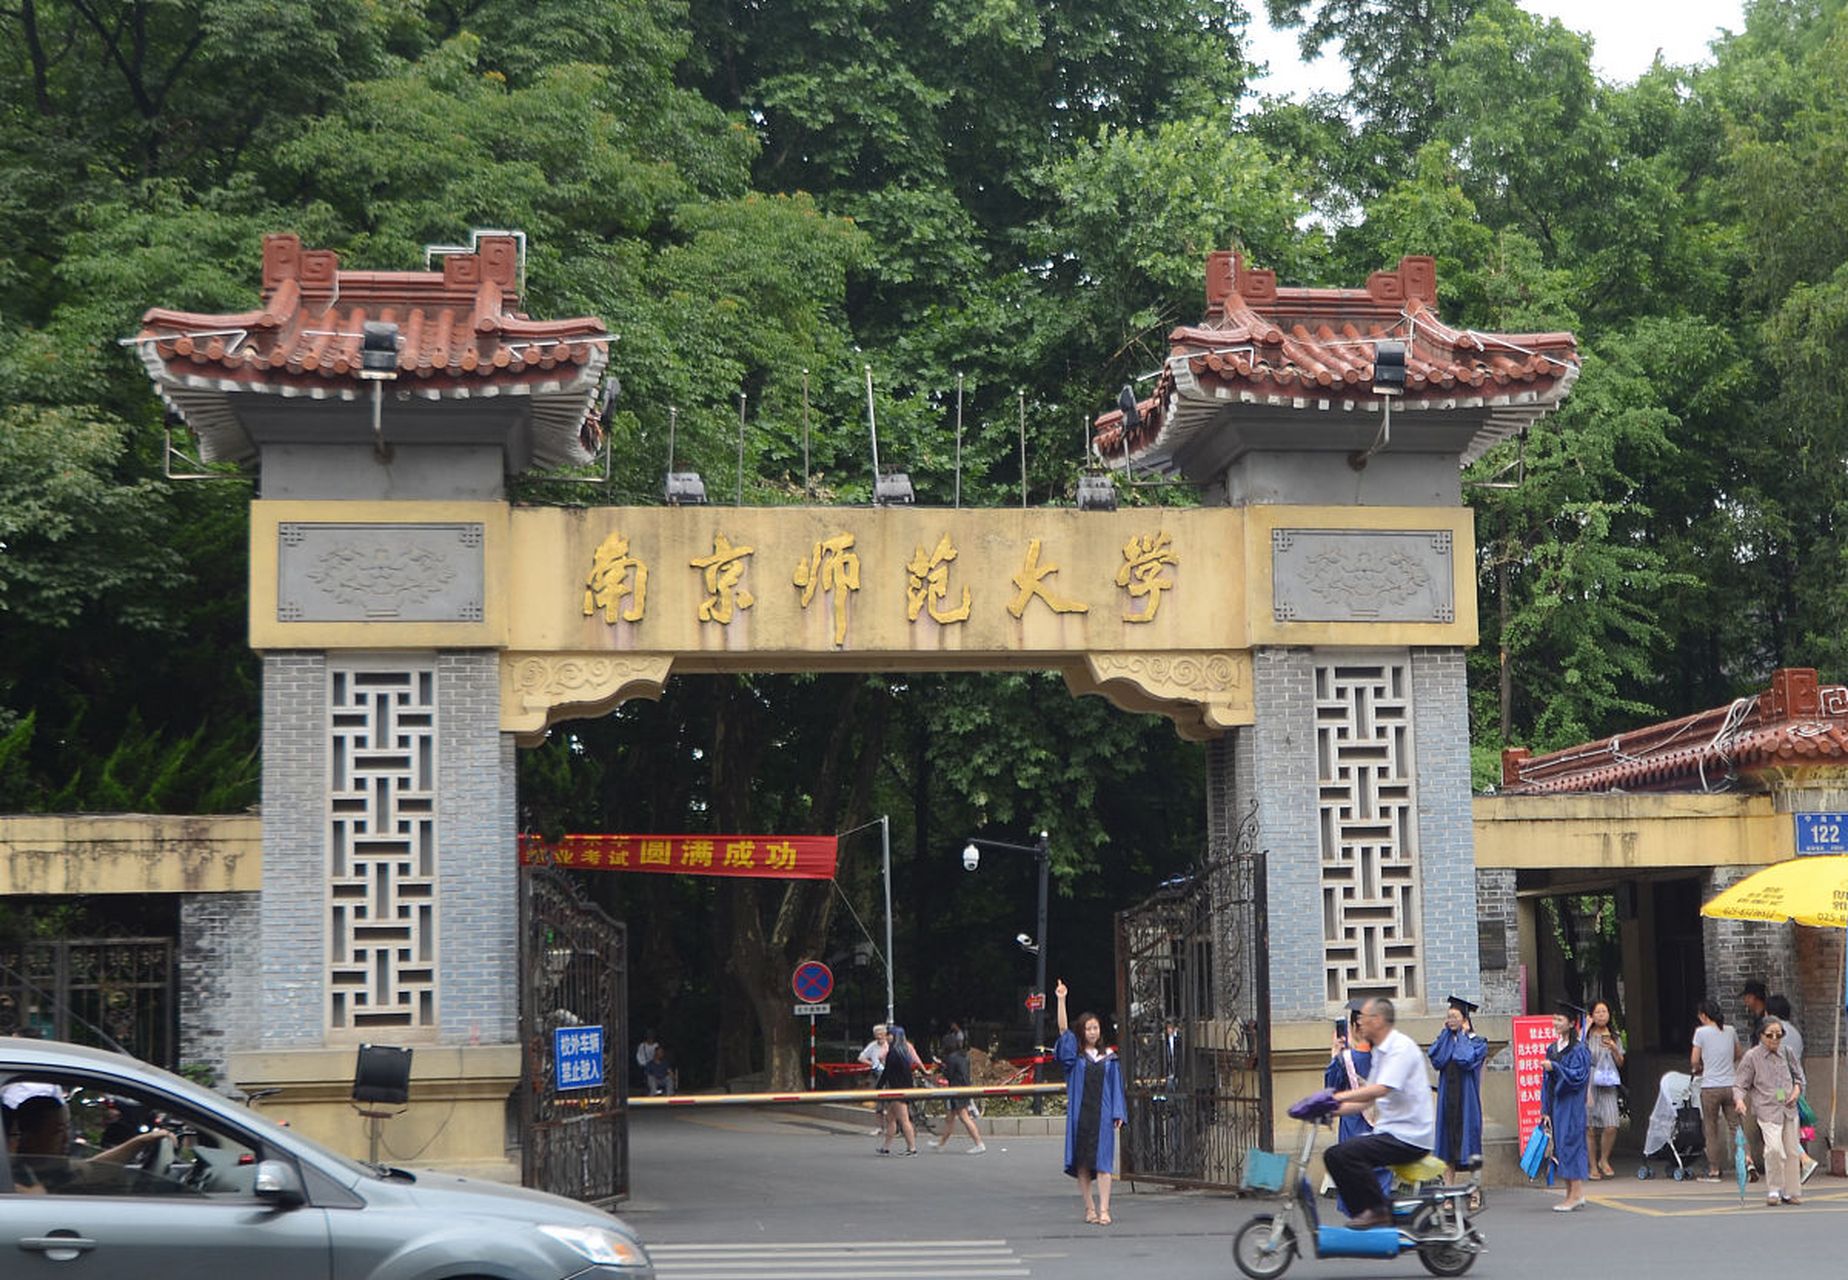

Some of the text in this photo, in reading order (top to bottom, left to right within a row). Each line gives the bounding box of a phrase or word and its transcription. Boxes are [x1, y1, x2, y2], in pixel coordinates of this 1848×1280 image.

[583, 530, 1180, 646] 南京师范大学
[1811, 825, 1840, 843] 122
[640, 840, 797, 869] 圆满成功
